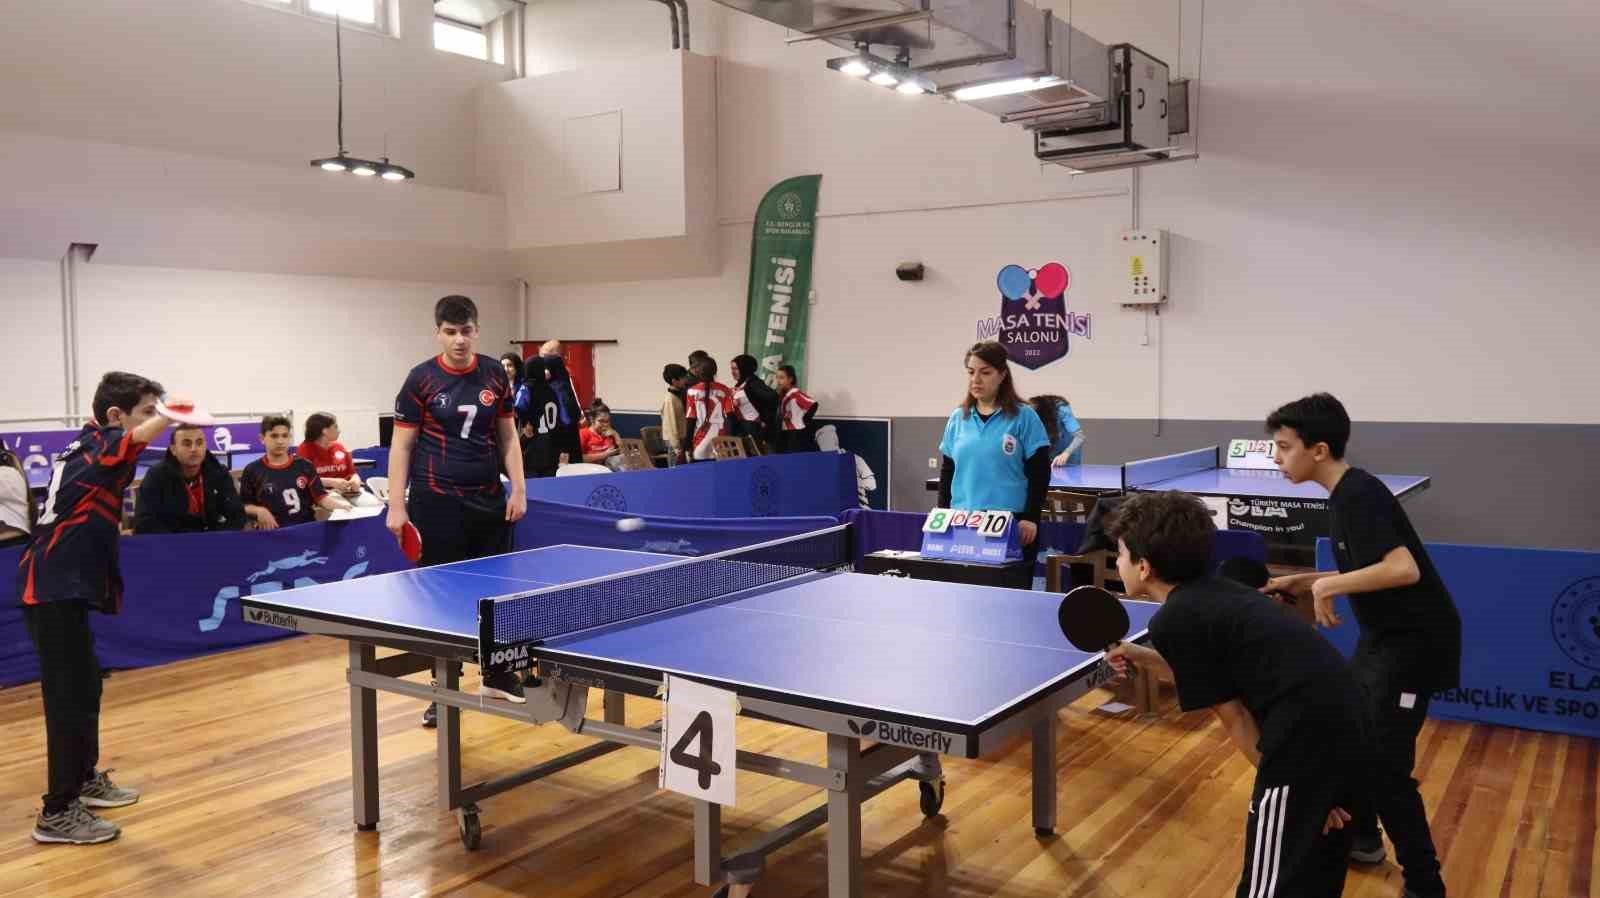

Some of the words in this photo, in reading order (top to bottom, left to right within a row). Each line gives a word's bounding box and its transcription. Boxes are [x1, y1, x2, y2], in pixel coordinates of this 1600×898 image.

[765, 257, 797, 347] TENİSİ
[976, 313, 1030, 340] MASA
[1007, 331, 1060, 343] SALONU
[457, 404, 478, 439] 7
[1231, 442, 1242, 455] 5
[282, 488, 301, 515] 9
[1280, 501, 1301, 509] MASA
[929, 512, 947, 530] 8
[953, 513, 966, 525] 0
[968, 514, 982, 526] 2
[984, 514, 1006, 534] 10
[263, 610, 298, 632] Butterfly
[490, 646, 529, 665] JOOLA
[1522, 695, 1550, 714] VE
[878, 722, 952, 754] Butterfly
[670, 710, 721, 790] 4
